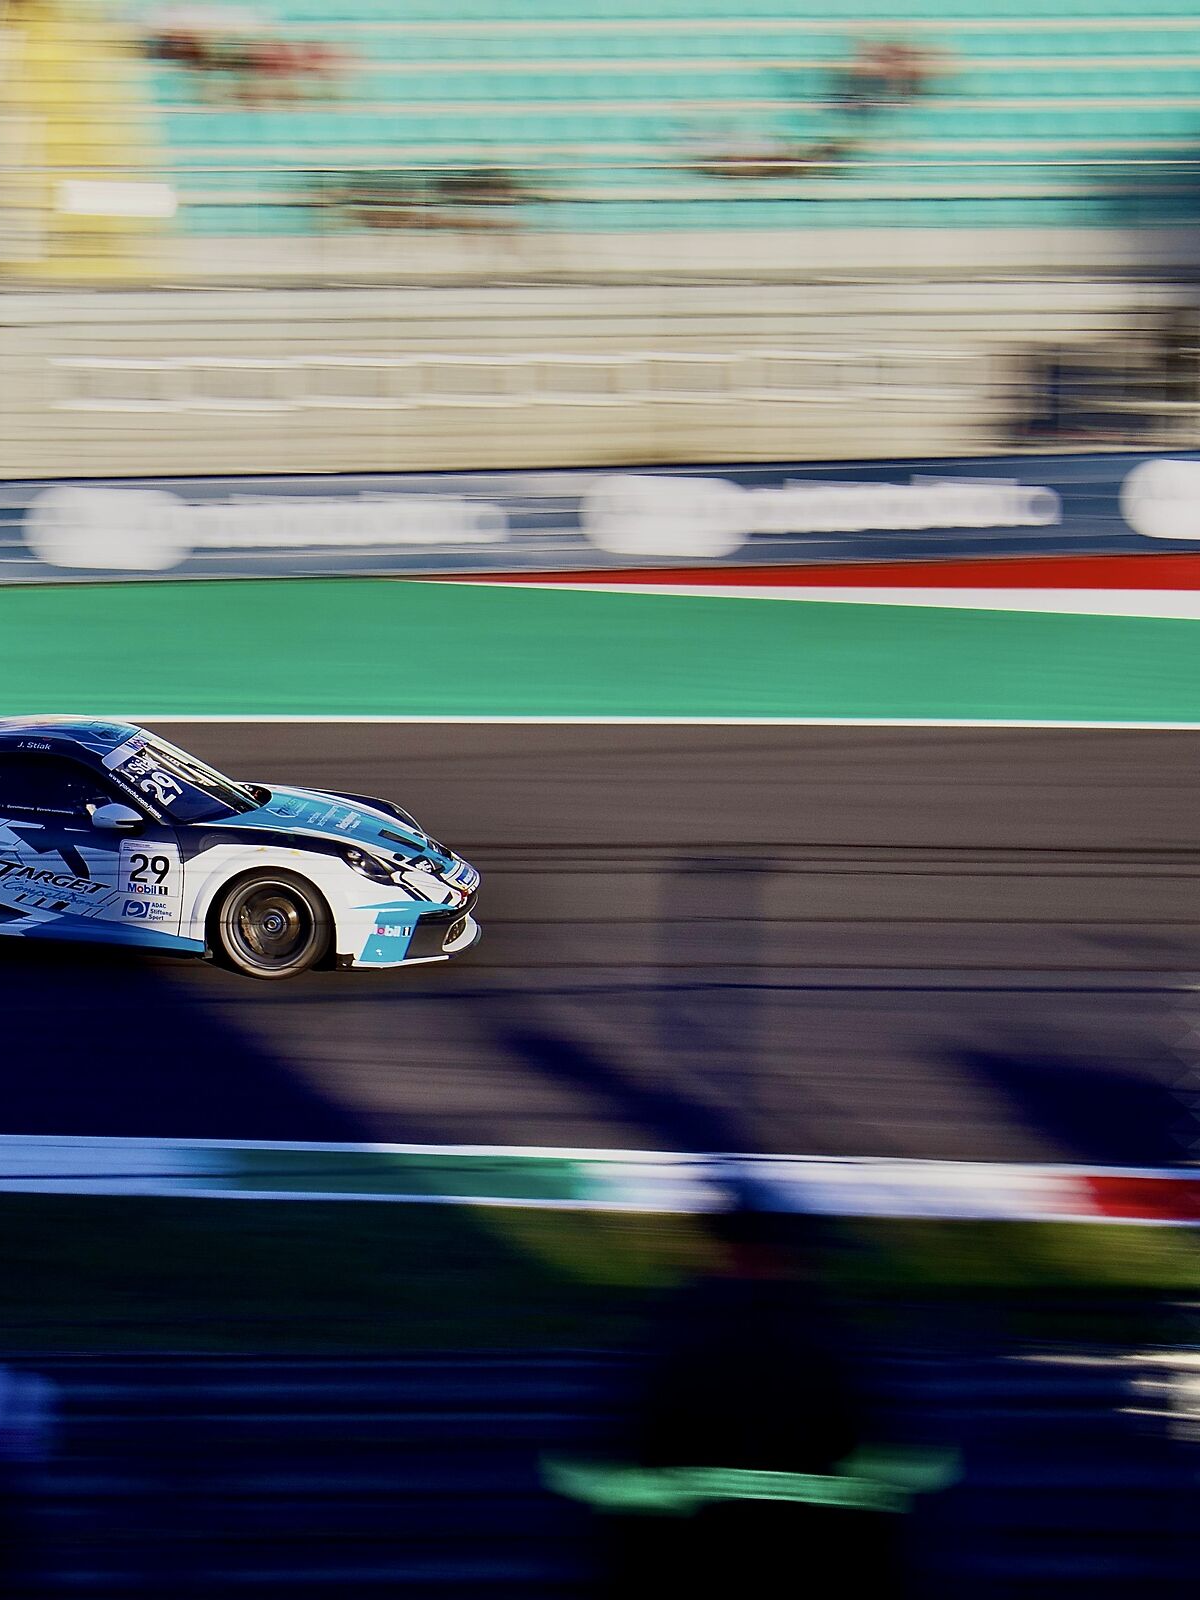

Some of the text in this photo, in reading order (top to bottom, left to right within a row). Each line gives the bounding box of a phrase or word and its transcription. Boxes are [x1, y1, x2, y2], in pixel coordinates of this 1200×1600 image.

[120, 769, 139, 783] J.
[140, 771, 183, 806] 29
[130, 853, 170, 884] 29
[127, 883, 169, 895] Mobil 1
[150, 909, 173, 917] Stiftung
